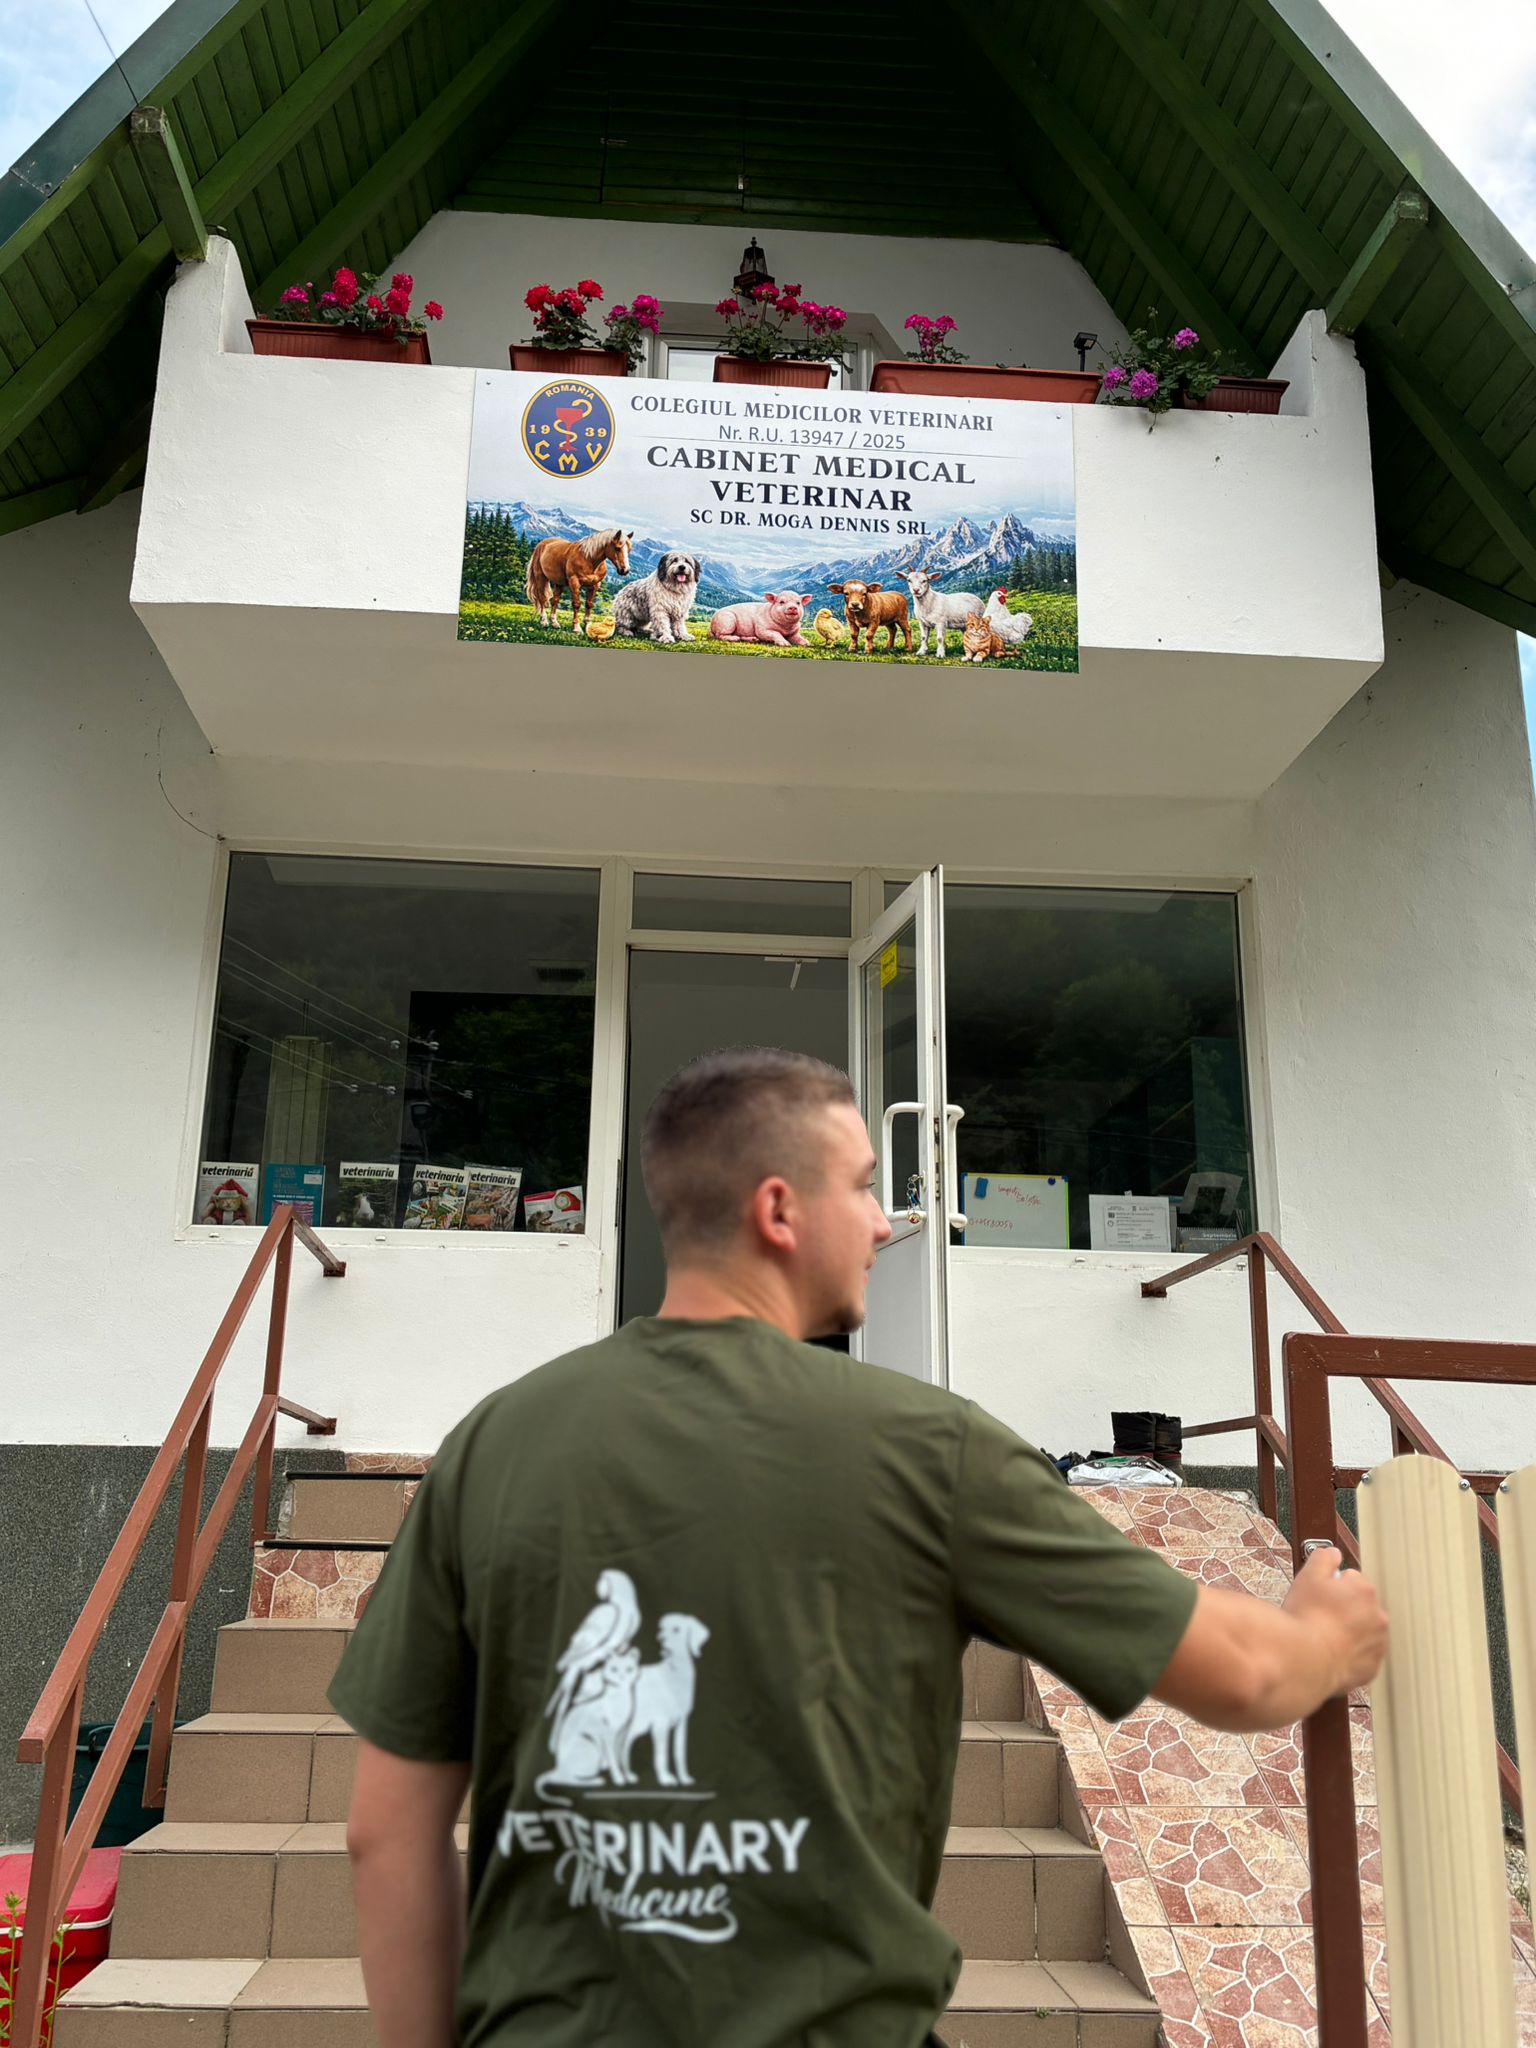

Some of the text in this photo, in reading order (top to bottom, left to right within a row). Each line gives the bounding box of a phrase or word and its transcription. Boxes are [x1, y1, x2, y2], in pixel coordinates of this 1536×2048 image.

[545, 384, 595, 400] ROMANIA
[630, 395, 993, 431] COLEGIUL MEDICILOR VETERINARI
[719, 425, 742, 441] Nr.
[749, 427, 783, 442] R.U.
[790, 429, 844, 446] 13947
[863, 433, 905, 450] 2025
[647, 445, 976, 485] CABINET MEDICAL
[710, 480, 913, 512] VETERINAR
[690, 509, 931, 536] SC DR. MOGA DENNIS SRL
[342, 1166, 395, 1178] veterinaria
[415, 1168, 465, 1184] veterinaria
